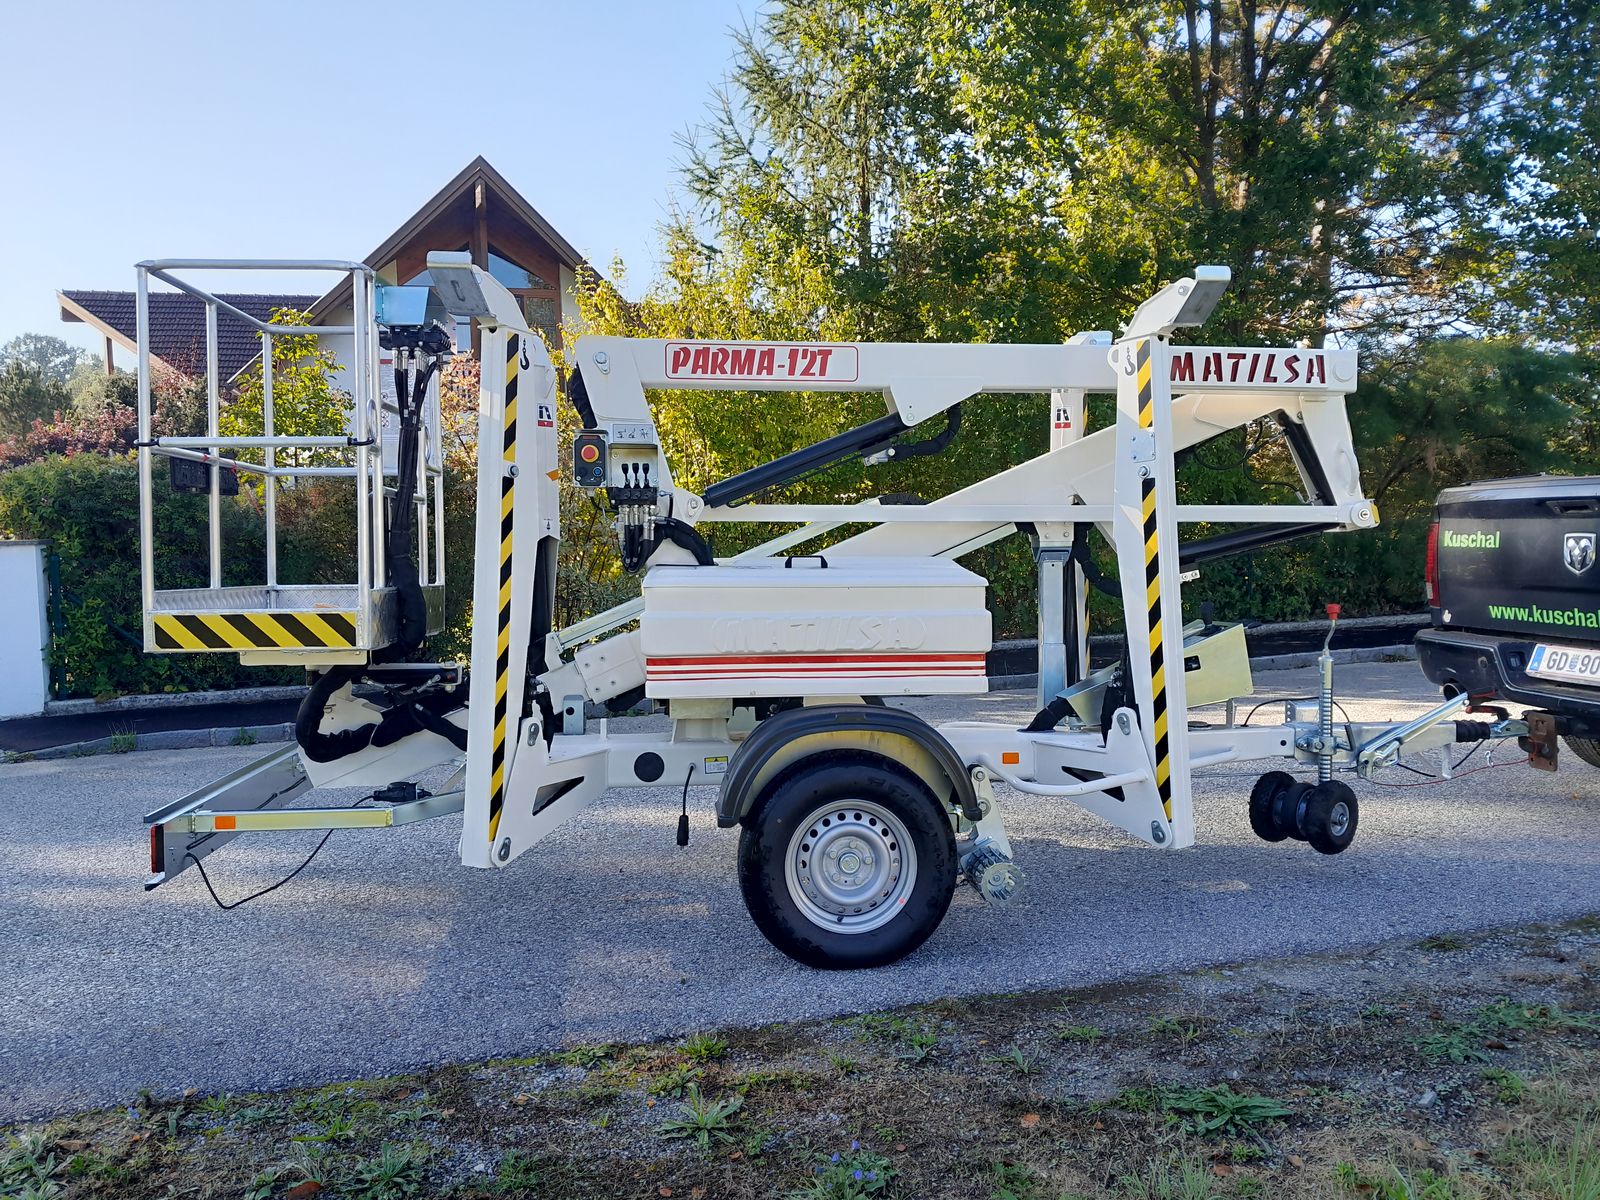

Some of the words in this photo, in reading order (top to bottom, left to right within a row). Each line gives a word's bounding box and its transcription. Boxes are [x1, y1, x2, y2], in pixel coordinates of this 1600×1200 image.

[671, 346, 833, 377] PARMA-12T
[1170, 352, 1326, 384] MATILSA
[1444, 530, 1500, 548] Kuschal
[1546, 651, 1569, 671] GD
